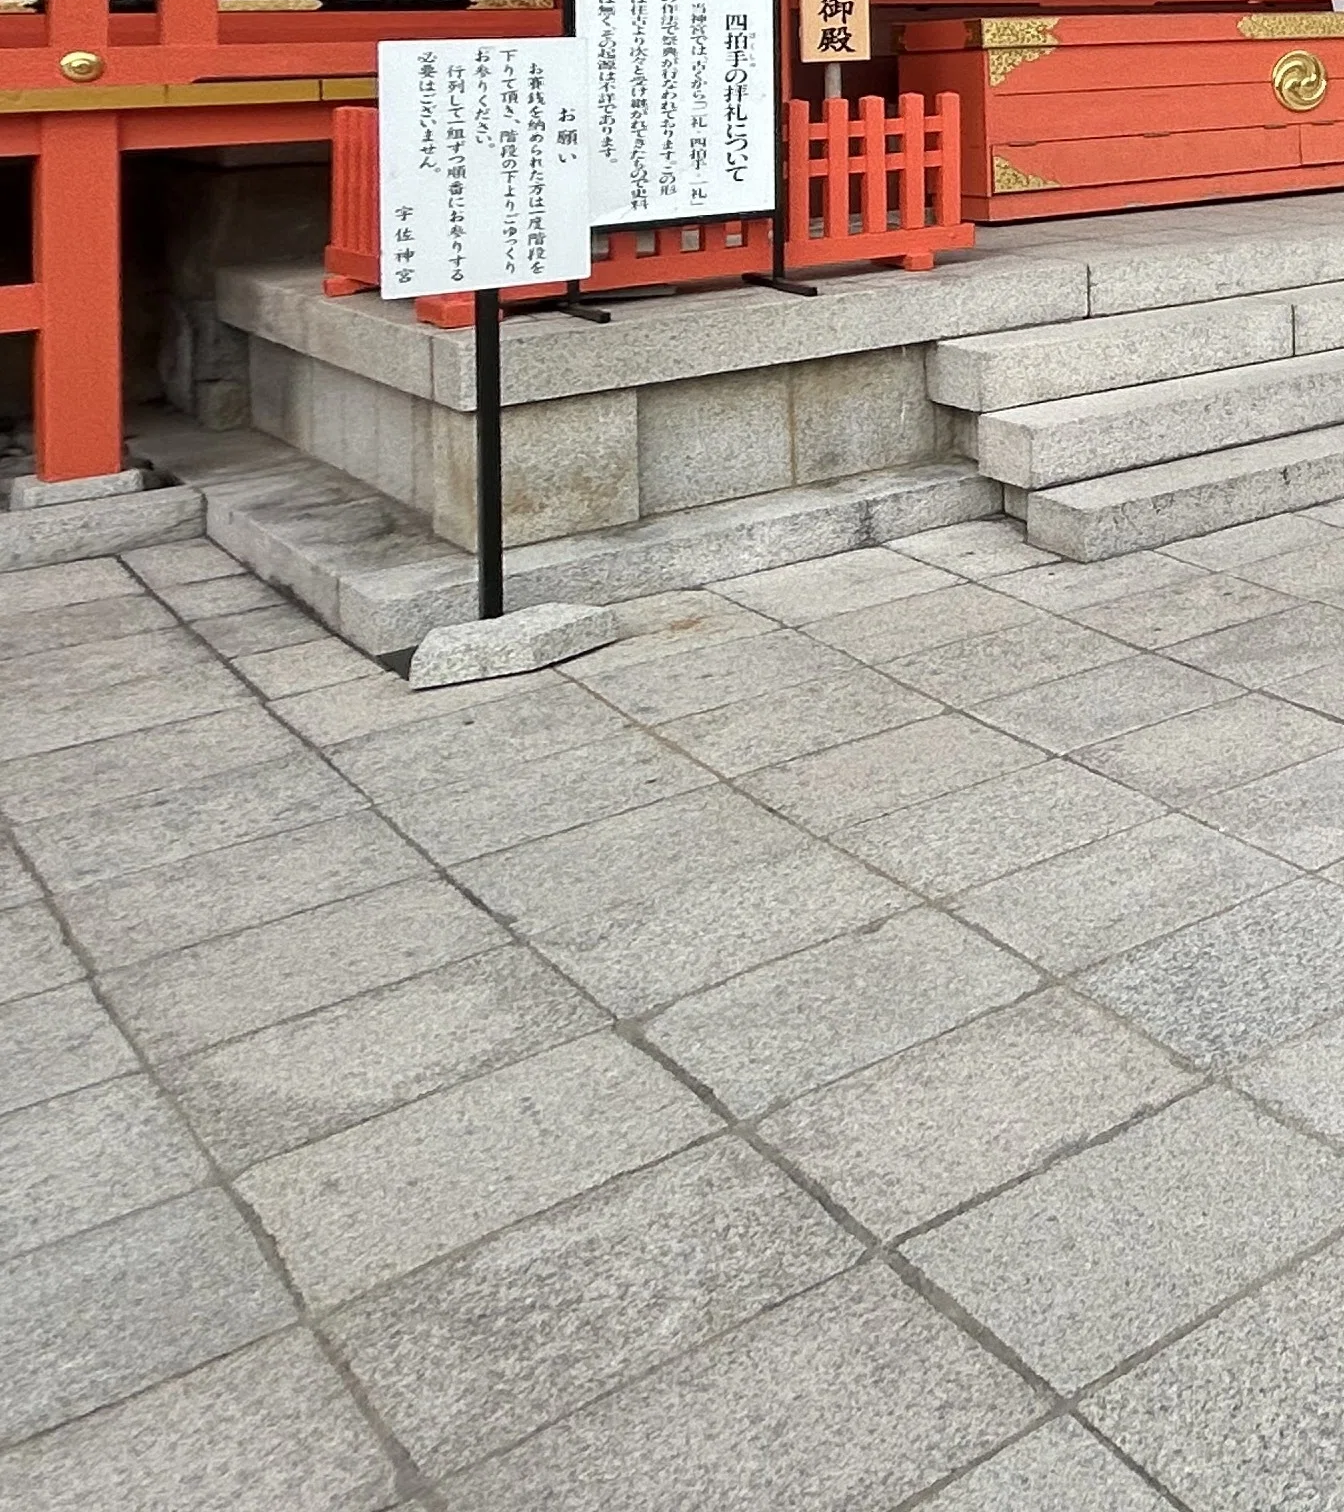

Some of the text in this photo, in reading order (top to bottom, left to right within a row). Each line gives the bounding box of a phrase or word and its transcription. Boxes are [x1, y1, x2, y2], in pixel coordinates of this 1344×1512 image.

[417, 51, 442, 173] 必要はございません。
[473, 50, 495, 149] お参りください。
[499, 49, 520, 274] 下りて頂き、階段の下よりごゆっくり
[527, 63, 547, 274] お賽銭を納められた方は一度階段を
[556, 107, 578, 164] お願い
[724, 13, 749, 182] 四拍手の拝礼について
[394, 206, 415, 283] 宇佐神宮
[446, 65, 467, 282] 行列して一組ずつ順番にお参りする
